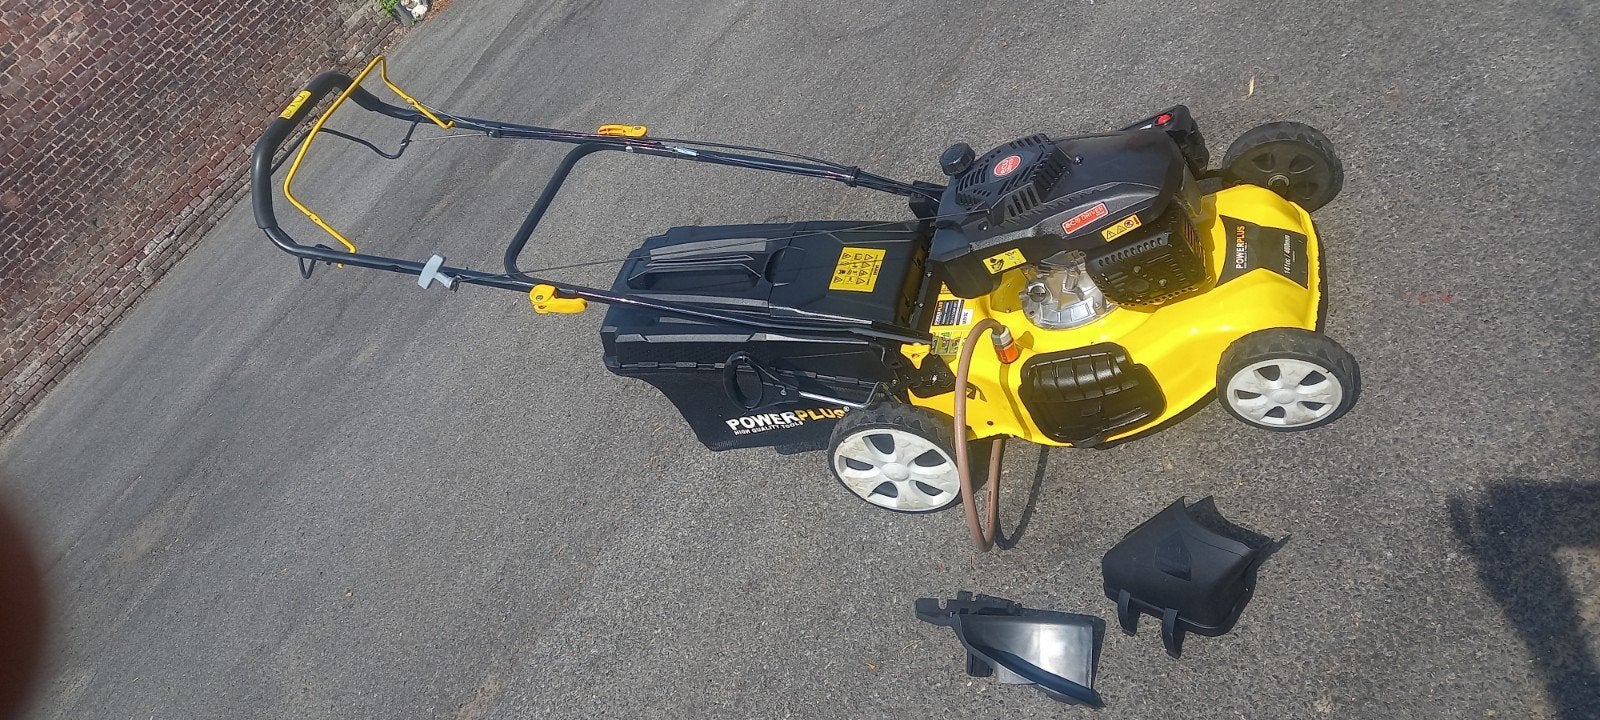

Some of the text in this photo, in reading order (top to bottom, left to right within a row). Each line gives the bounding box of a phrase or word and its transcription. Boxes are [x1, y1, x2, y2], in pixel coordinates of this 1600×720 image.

[1236, 226, 1245, 269] POWERPLUS
[734, 420, 804, 436] HIGH QUALITY TOOLS
